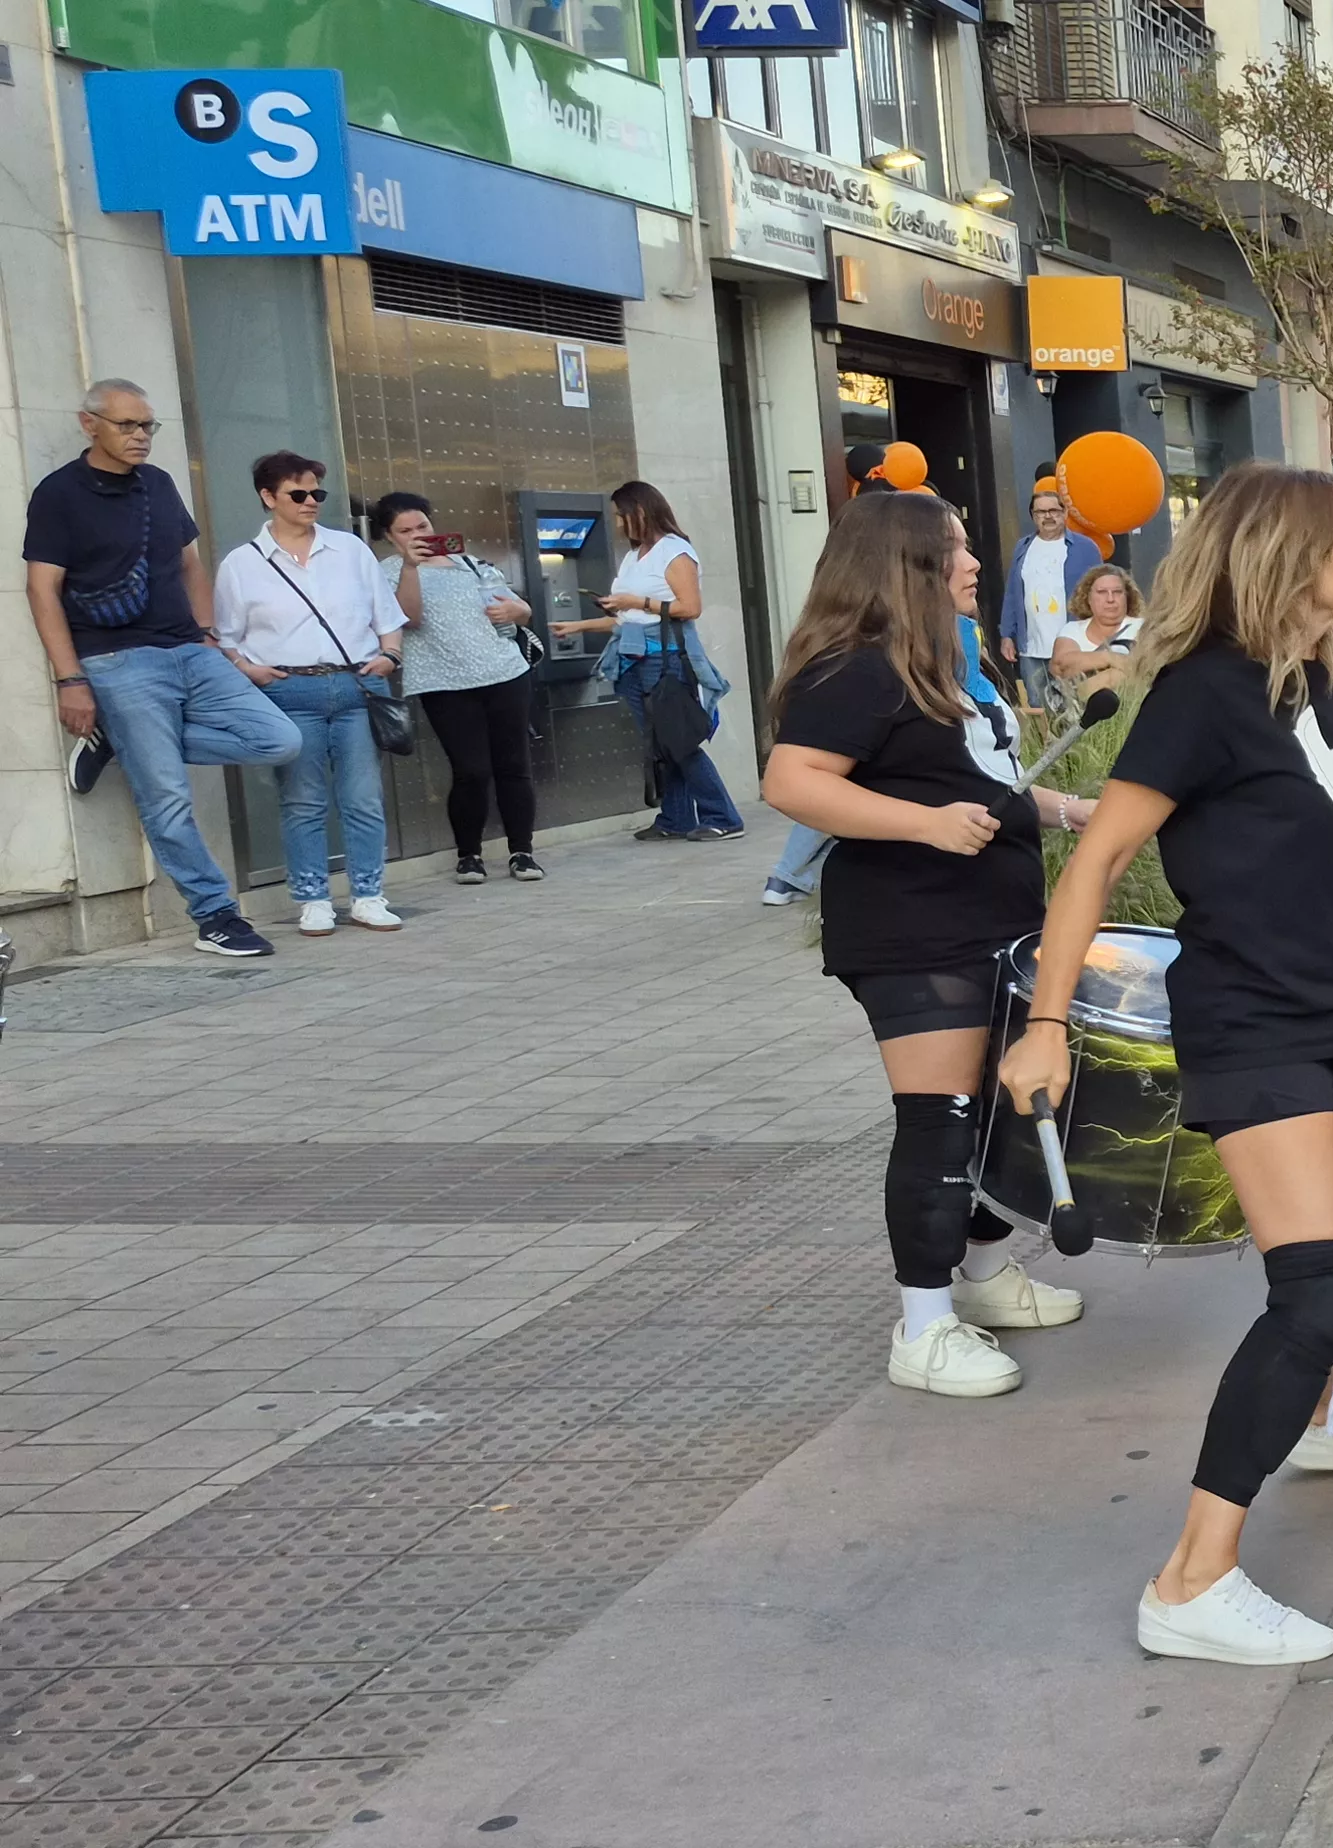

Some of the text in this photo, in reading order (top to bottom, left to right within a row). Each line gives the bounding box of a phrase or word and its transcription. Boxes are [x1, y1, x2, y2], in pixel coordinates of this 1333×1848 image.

[192, 90, 319, 179] B S
[195, 193, 328, 243] ATM
[921, 276, 985, 339] Orange
[1034, 346, 1116, 368] orange
